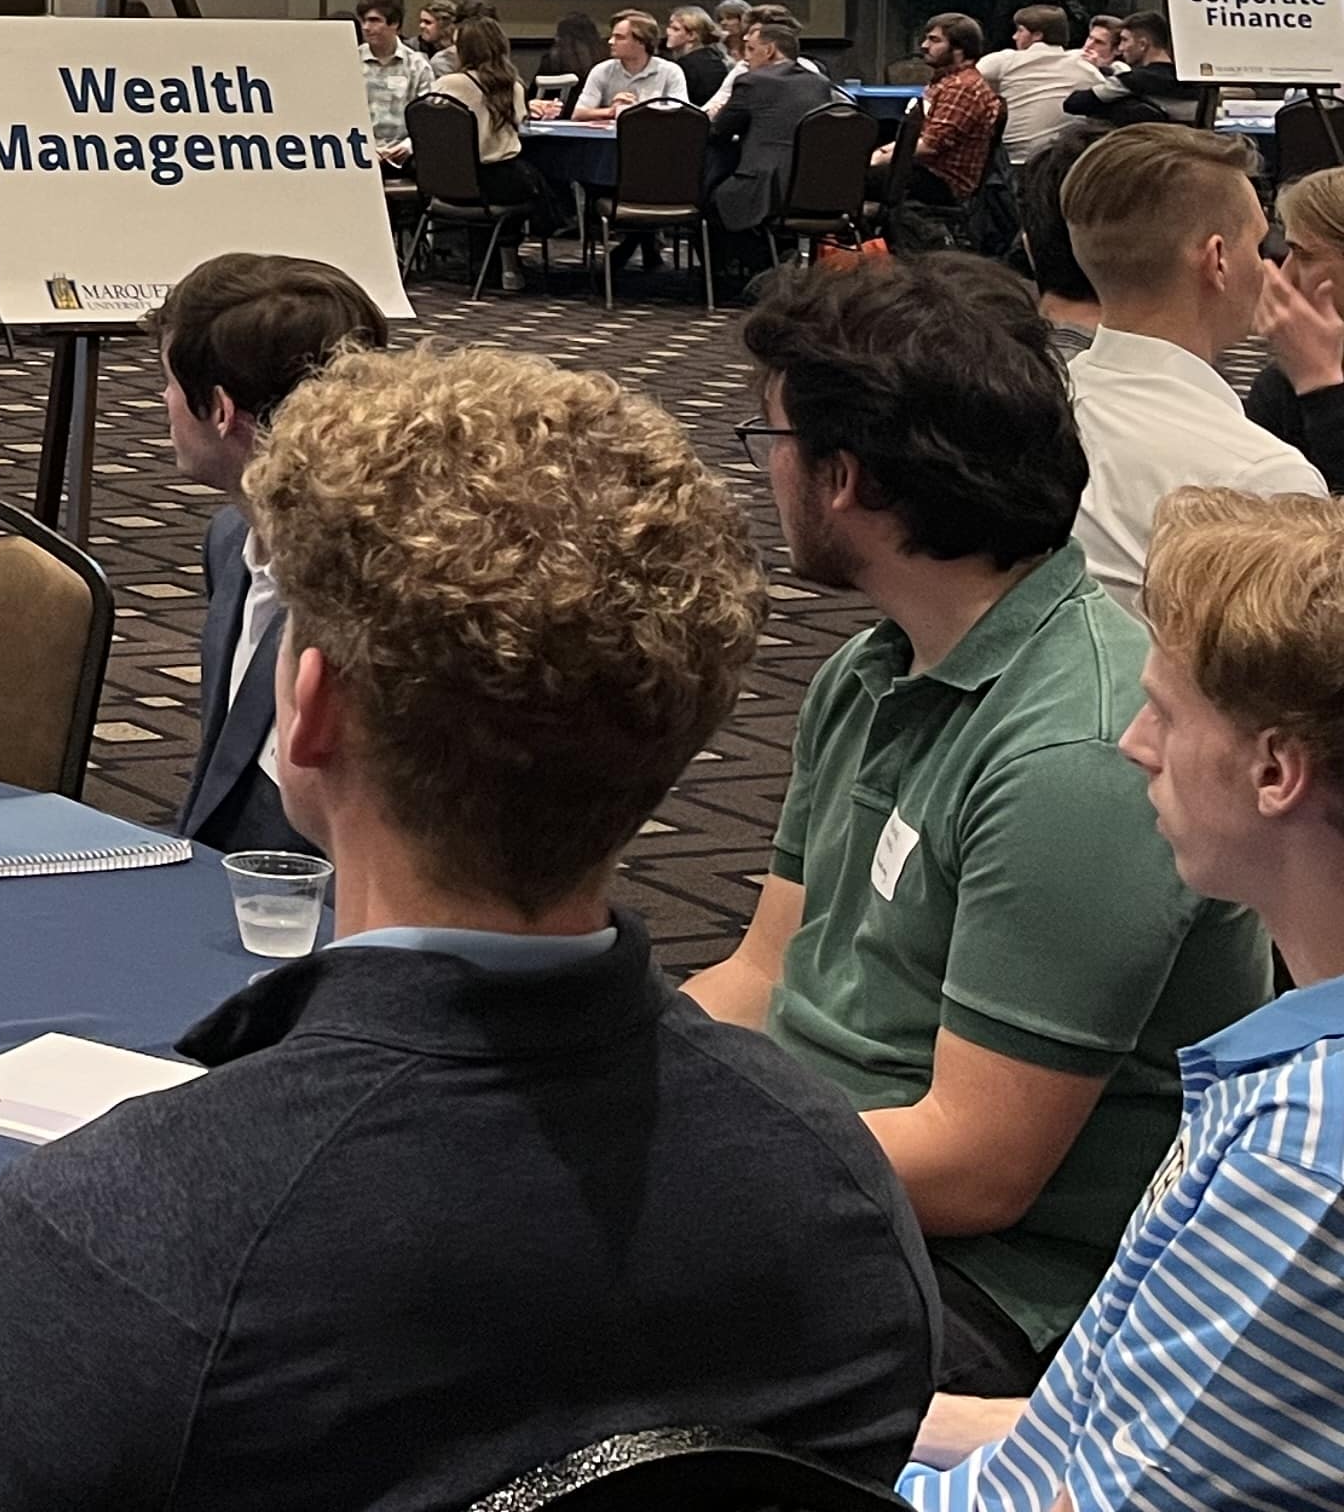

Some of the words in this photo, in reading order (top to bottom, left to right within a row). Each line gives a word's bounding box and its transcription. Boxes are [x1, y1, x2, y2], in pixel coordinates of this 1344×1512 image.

[1206, 6, 1313, 28] Finance
[59, 65, 274, 115] Wealth
[81, 283, 175, 300] MARQUE
